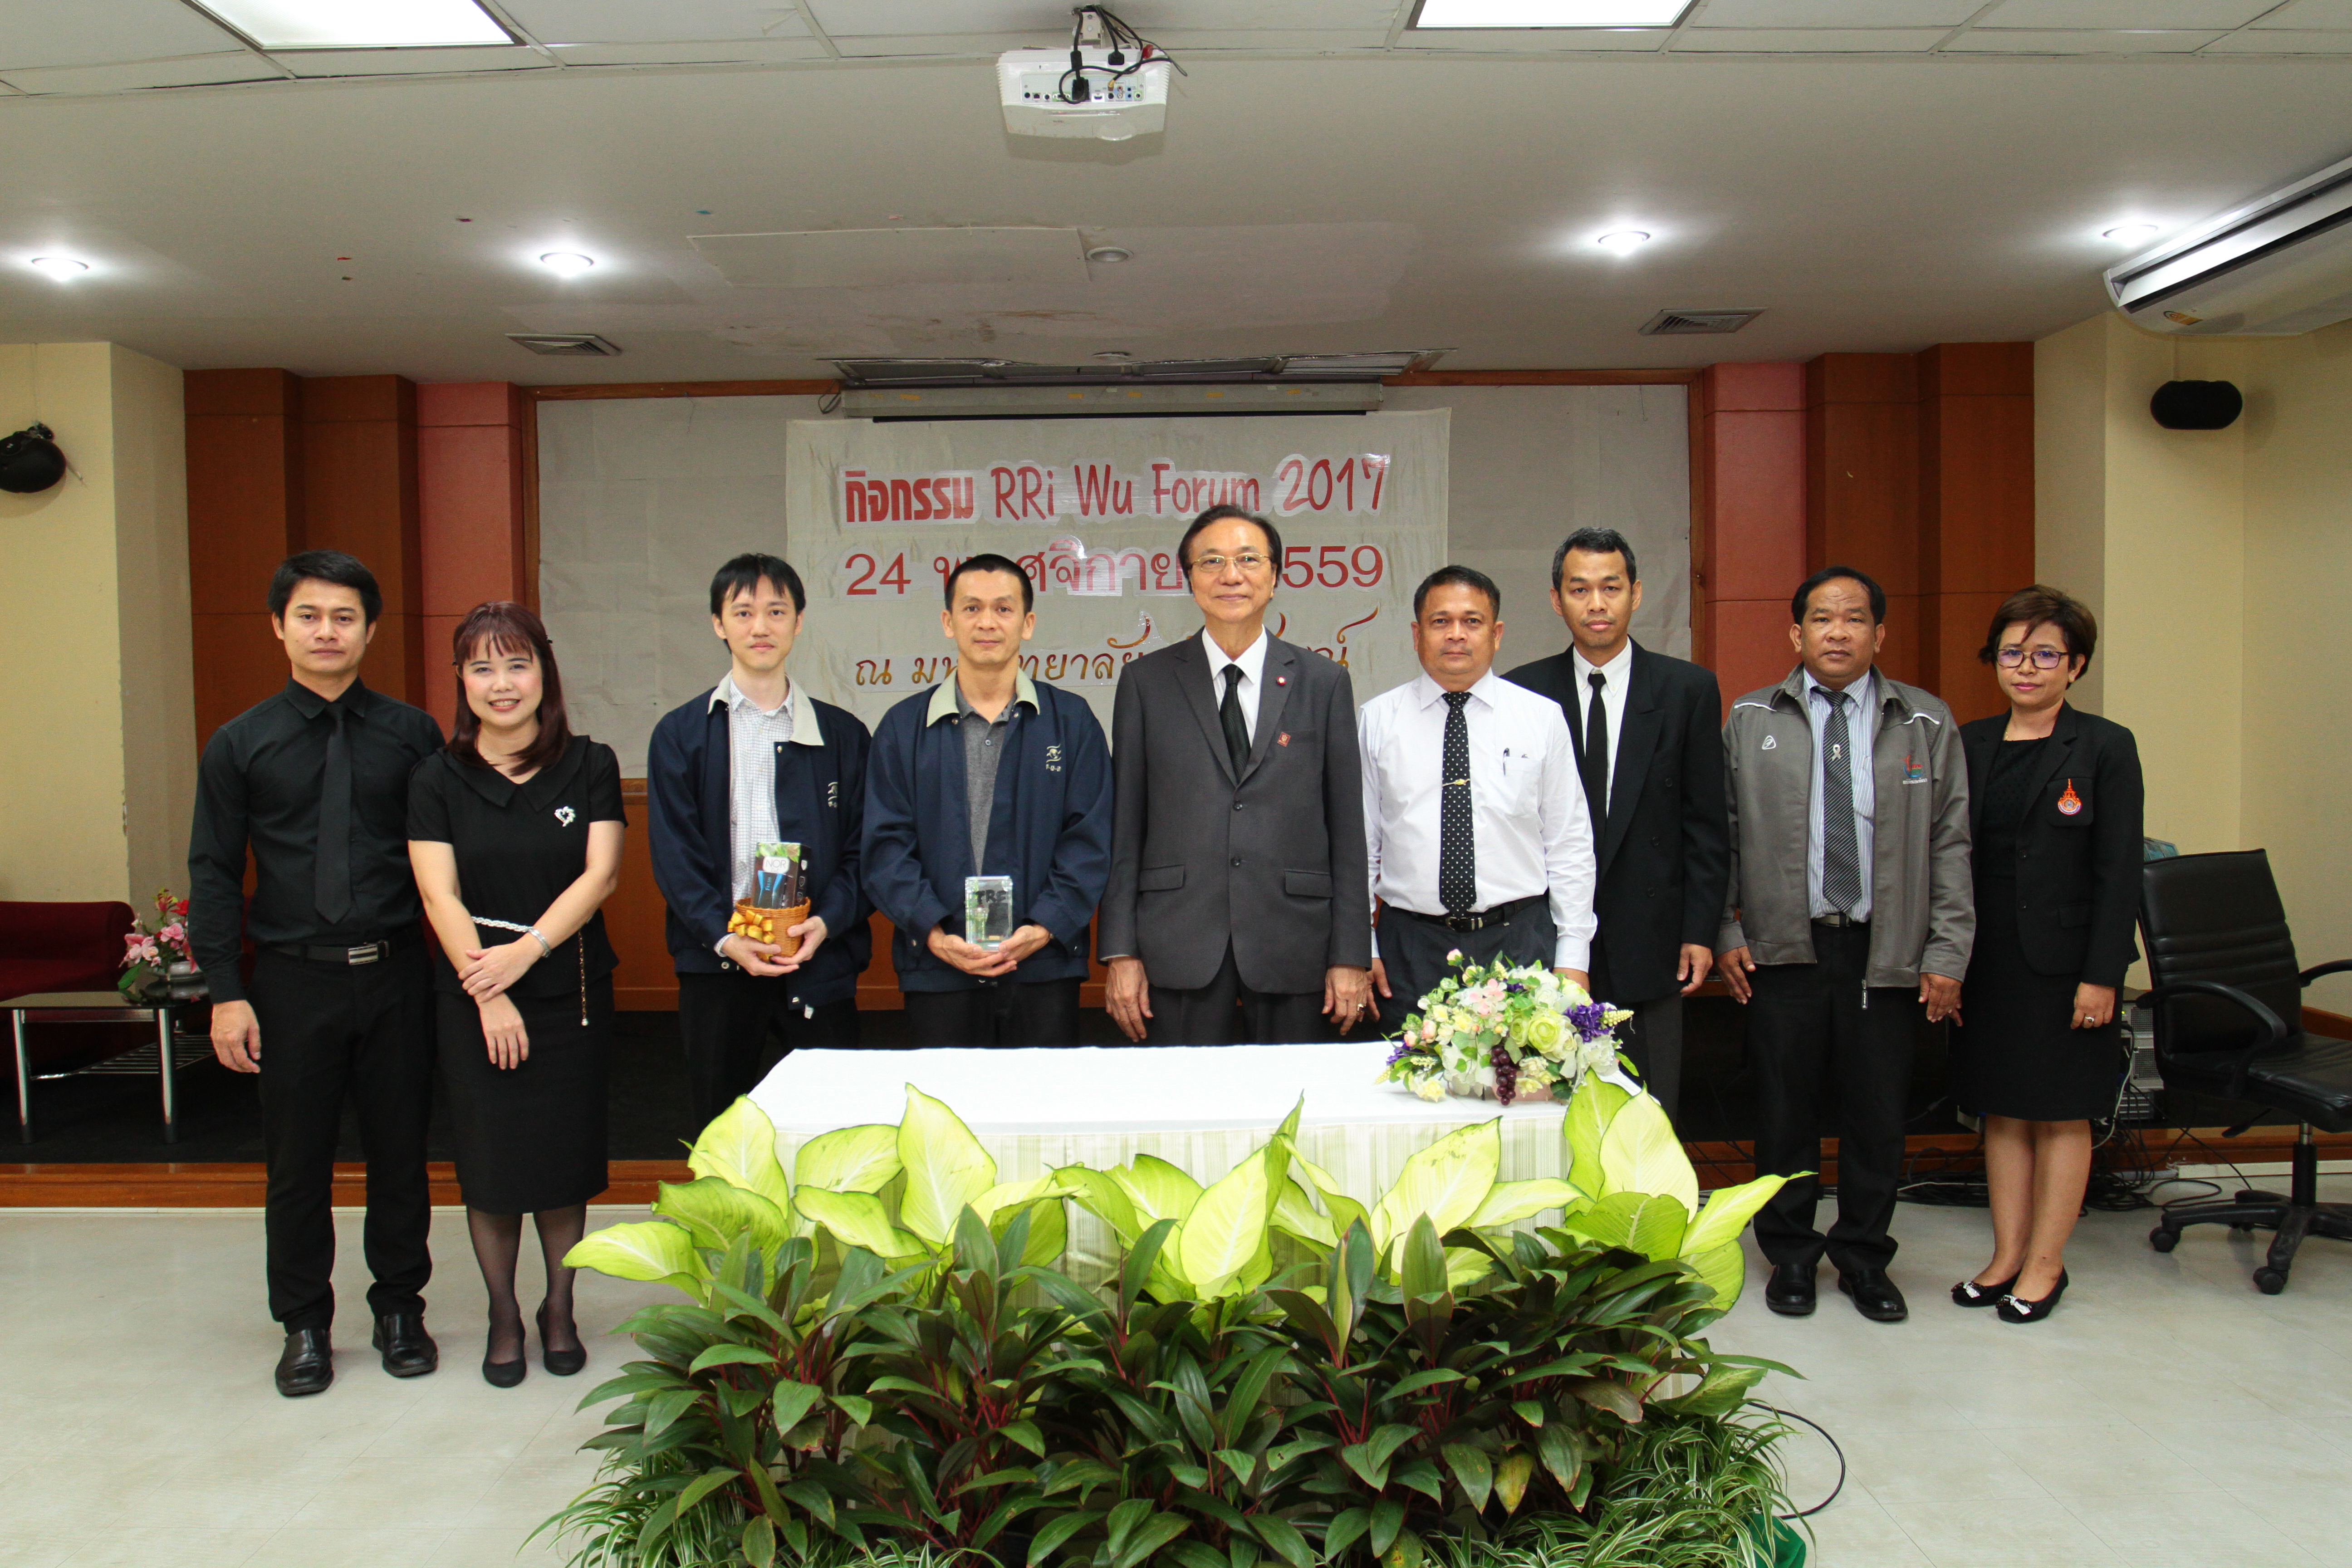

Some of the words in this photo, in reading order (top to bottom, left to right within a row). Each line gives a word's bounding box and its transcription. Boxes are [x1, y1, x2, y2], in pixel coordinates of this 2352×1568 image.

[845, 470, 974, 523] กิจกรรม
[991, 466, 1054, 521] RRi
[1074, 464, 1132, 516] Wu
[1152, 463, 1259, 514] Forum
[1280, 458, 1385, 511] 2017
[845, 553, 911, 595] 24
[1276, 545, 1383, 588] 559
